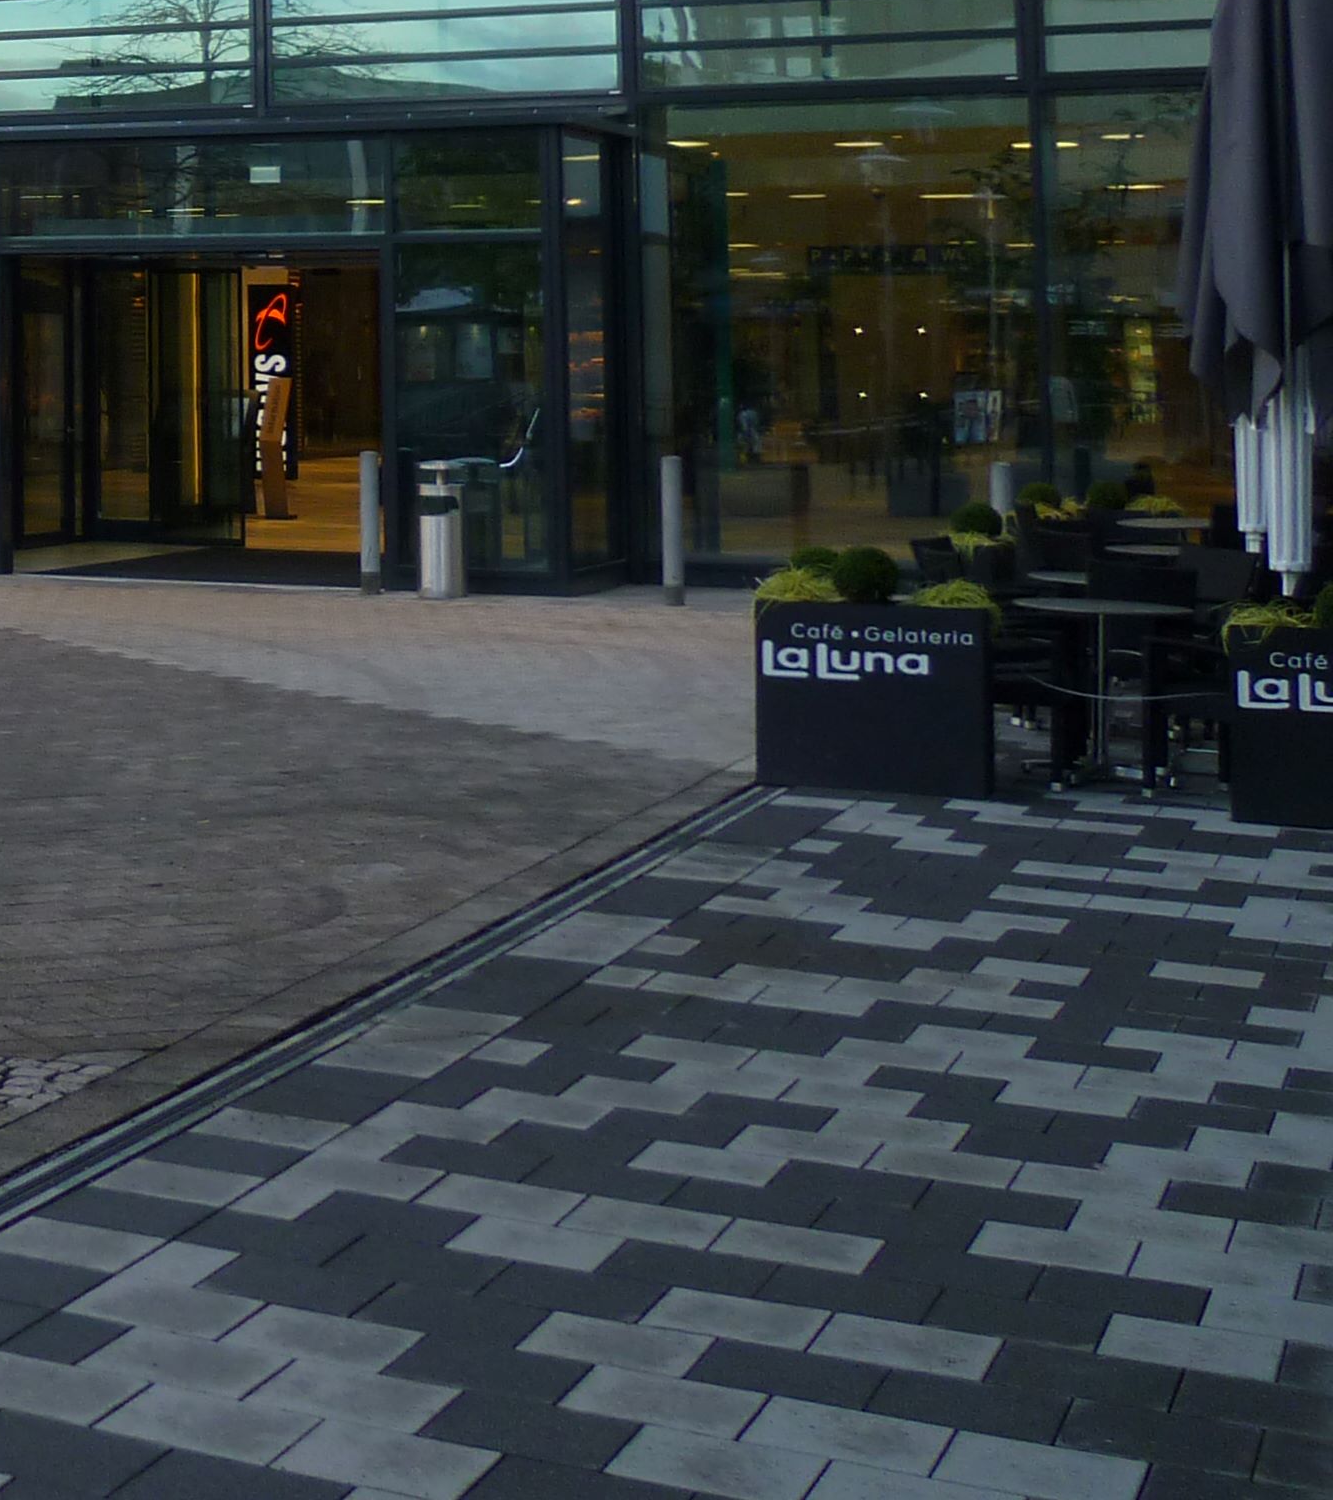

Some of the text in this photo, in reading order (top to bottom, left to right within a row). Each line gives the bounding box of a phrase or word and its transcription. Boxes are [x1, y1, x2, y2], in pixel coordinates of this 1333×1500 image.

[791, 622, 974, 646] Café Gelateria
[1269, 652, 1329, 670] Café
